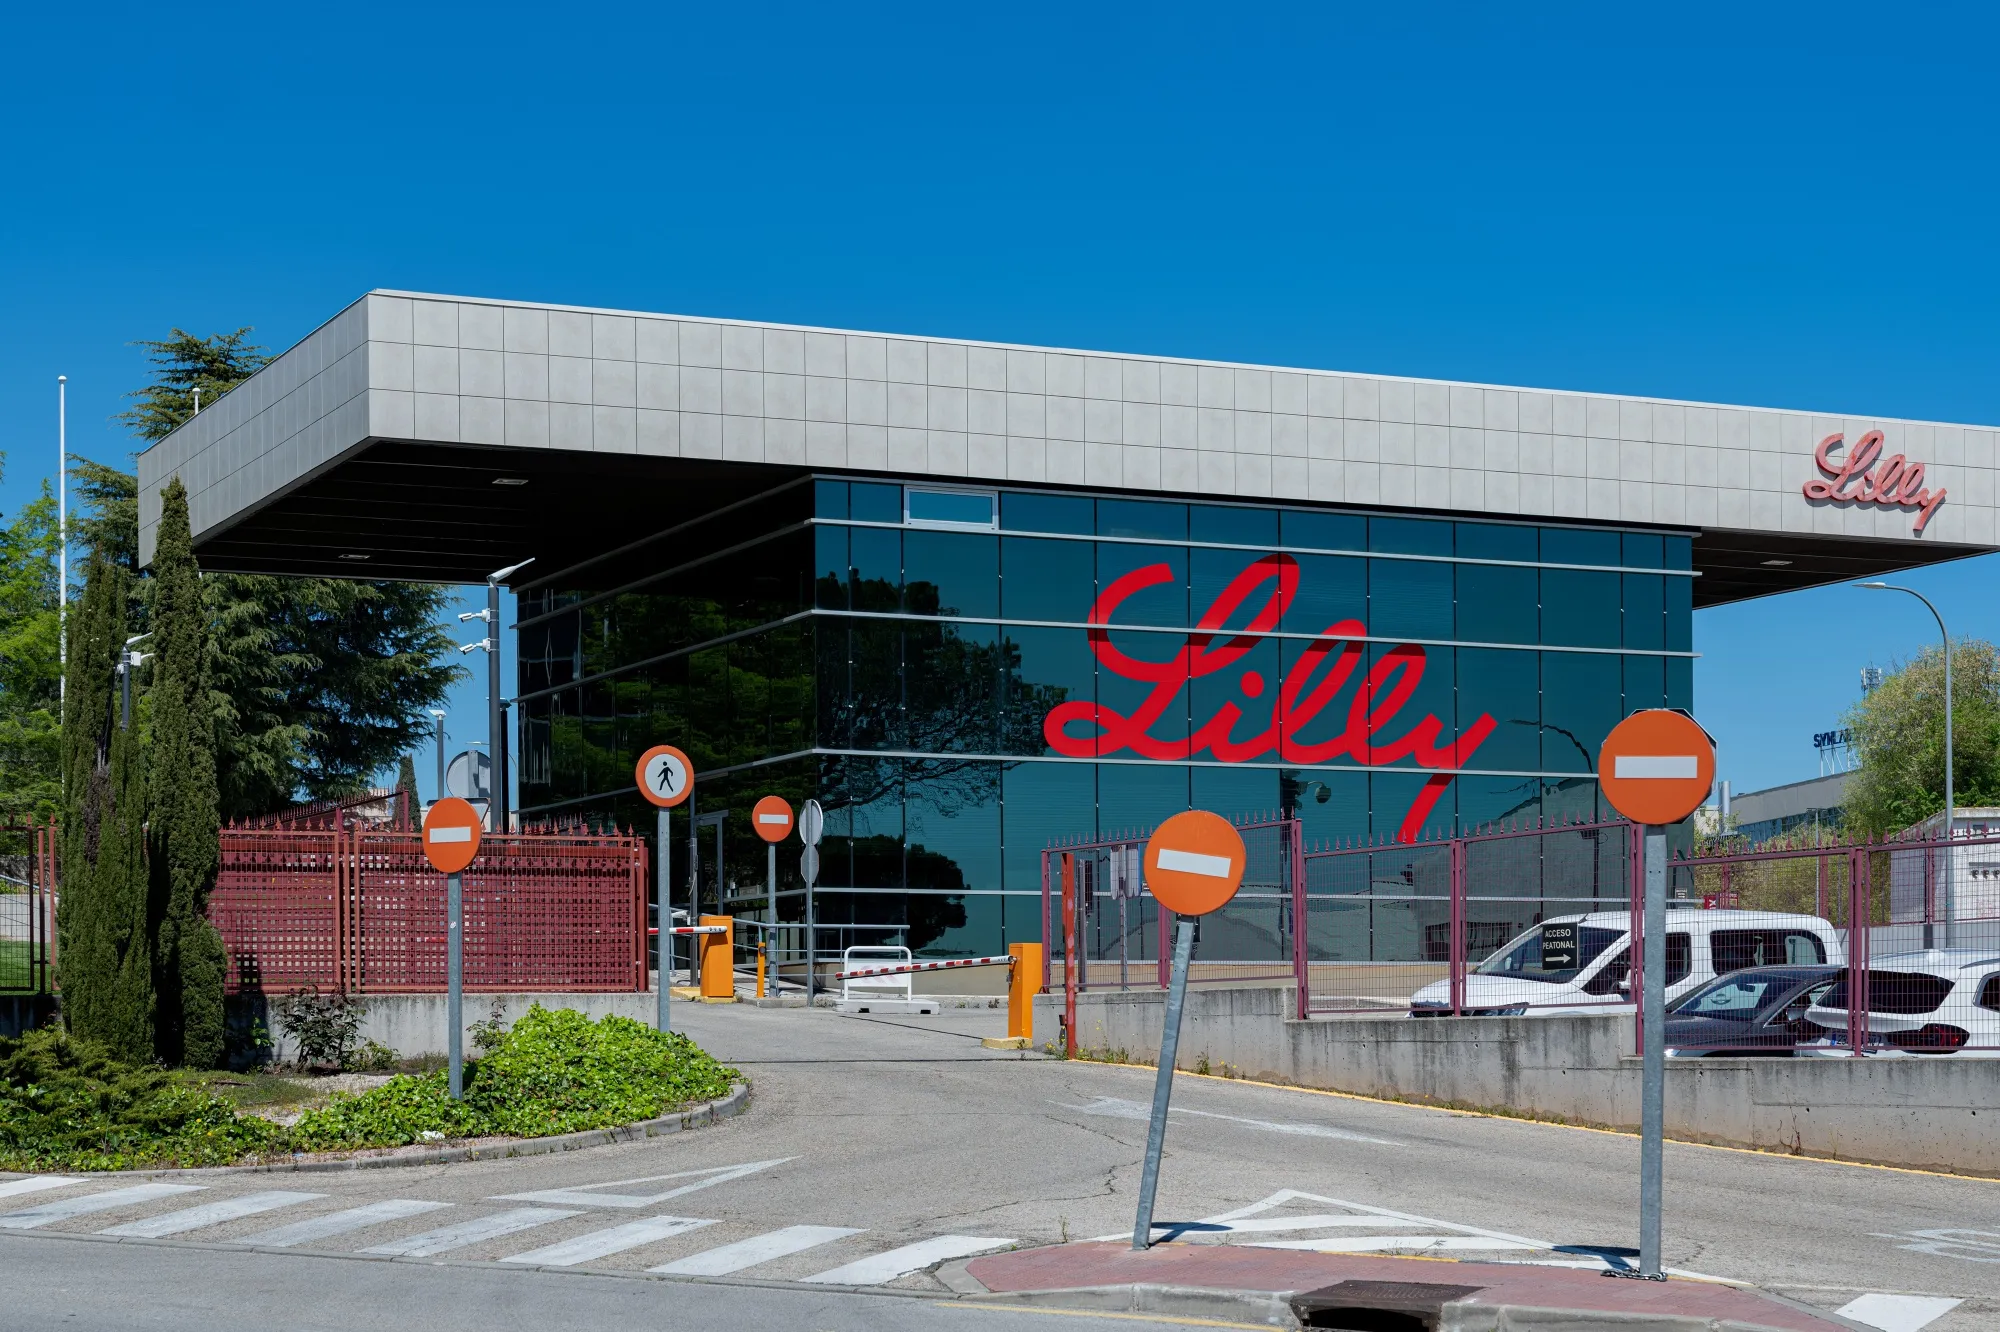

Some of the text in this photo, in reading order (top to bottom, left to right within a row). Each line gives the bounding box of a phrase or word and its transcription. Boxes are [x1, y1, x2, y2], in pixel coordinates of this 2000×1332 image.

[1803, 429, 1948, 532] Lilly
[1043, 553, 1499, 845] Lilly
[1542, 940, 1576, 950] PEATONAL
[1544, 928, 1572, 938] ACCESO
